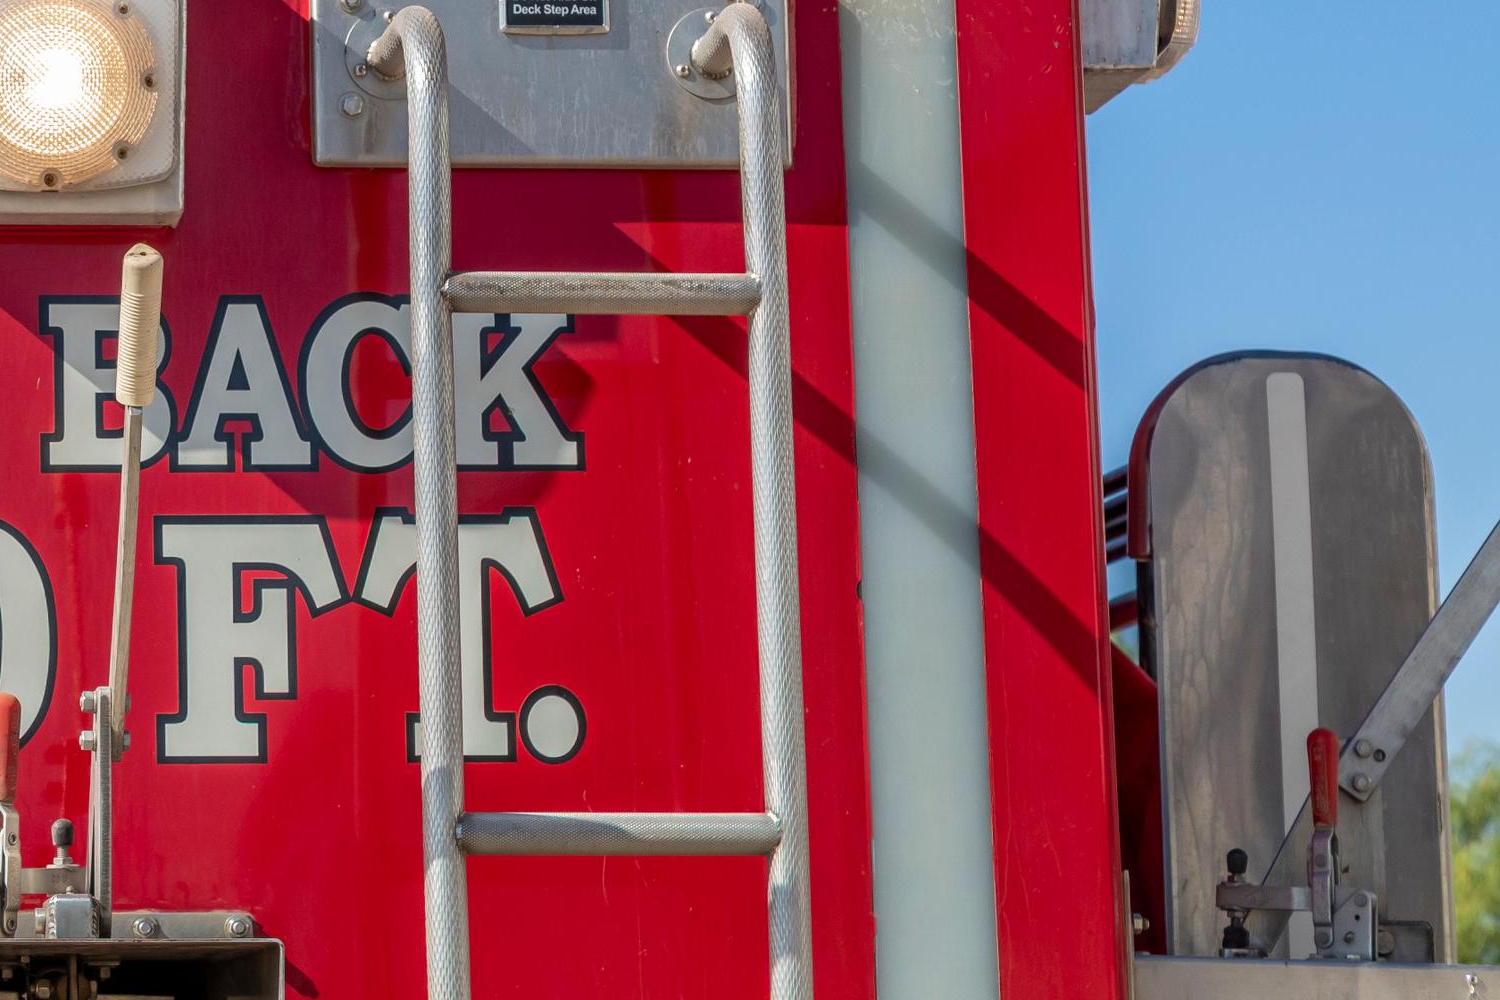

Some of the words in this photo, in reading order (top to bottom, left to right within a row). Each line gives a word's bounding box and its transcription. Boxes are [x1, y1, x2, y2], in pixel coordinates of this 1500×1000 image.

[513, 4, 542, 15] Deck
[543, 4, 570, 17] Step
[571, 4, 597, 15] Area
[39, 293, 586, 474] BACK
[153, 506, 587, 766] FT.
